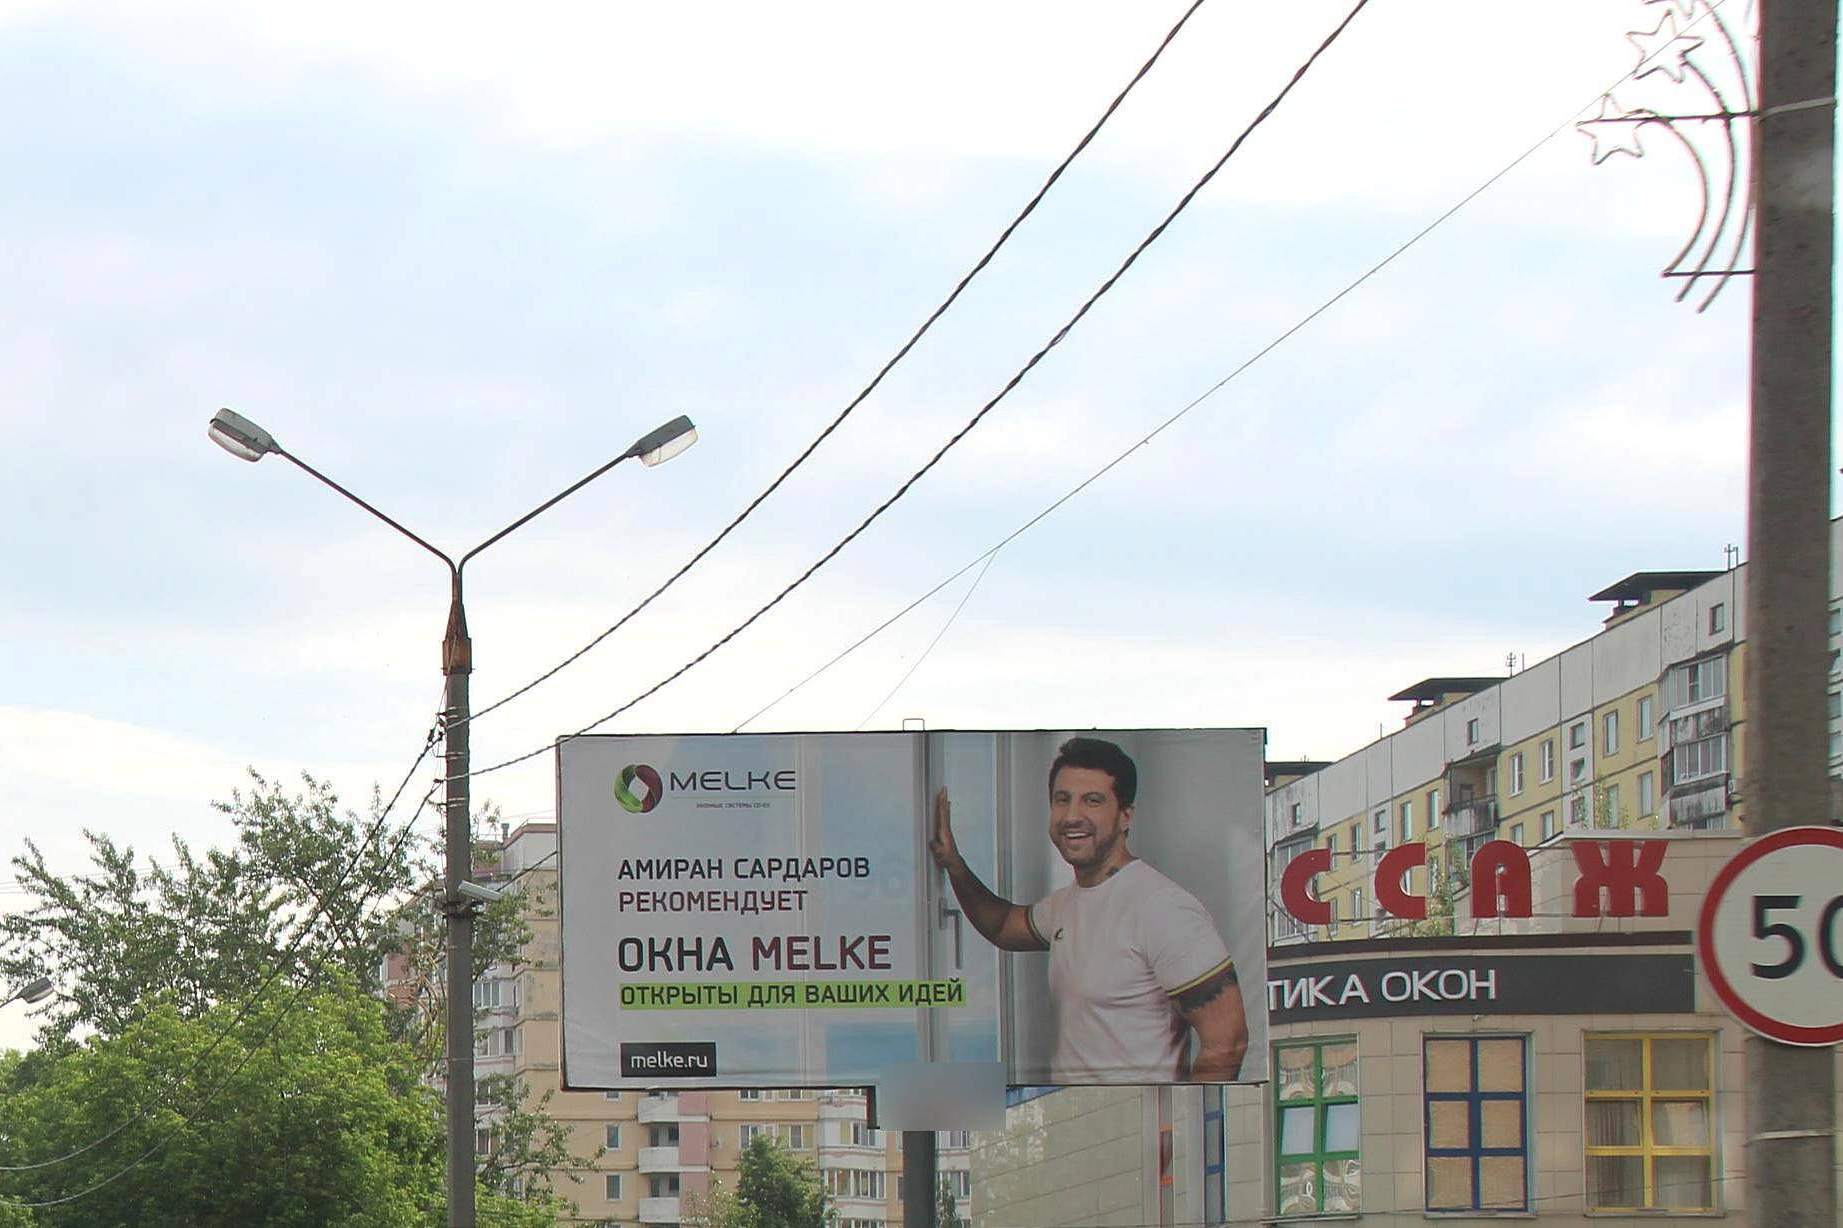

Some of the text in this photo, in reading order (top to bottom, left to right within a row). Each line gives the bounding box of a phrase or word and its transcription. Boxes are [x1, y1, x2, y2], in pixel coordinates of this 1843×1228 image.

[670, 770, 796, 791] MELKE
[618, 857, 870, 883] АМИРАН САРДАРОВ
[619, 890, 808, 915] РЕКОМЕНДУЕТ
[618, 935, 892, 972] ОКНА MELKE
[621, 977, 962, 1007] ОТКРЫТЫ ДЛЯ ВАШИХ ИДЕЙ
[1381, 968, 1496, 1003] ОКОН
[631, 1050, 708, 1069] melke.ru
